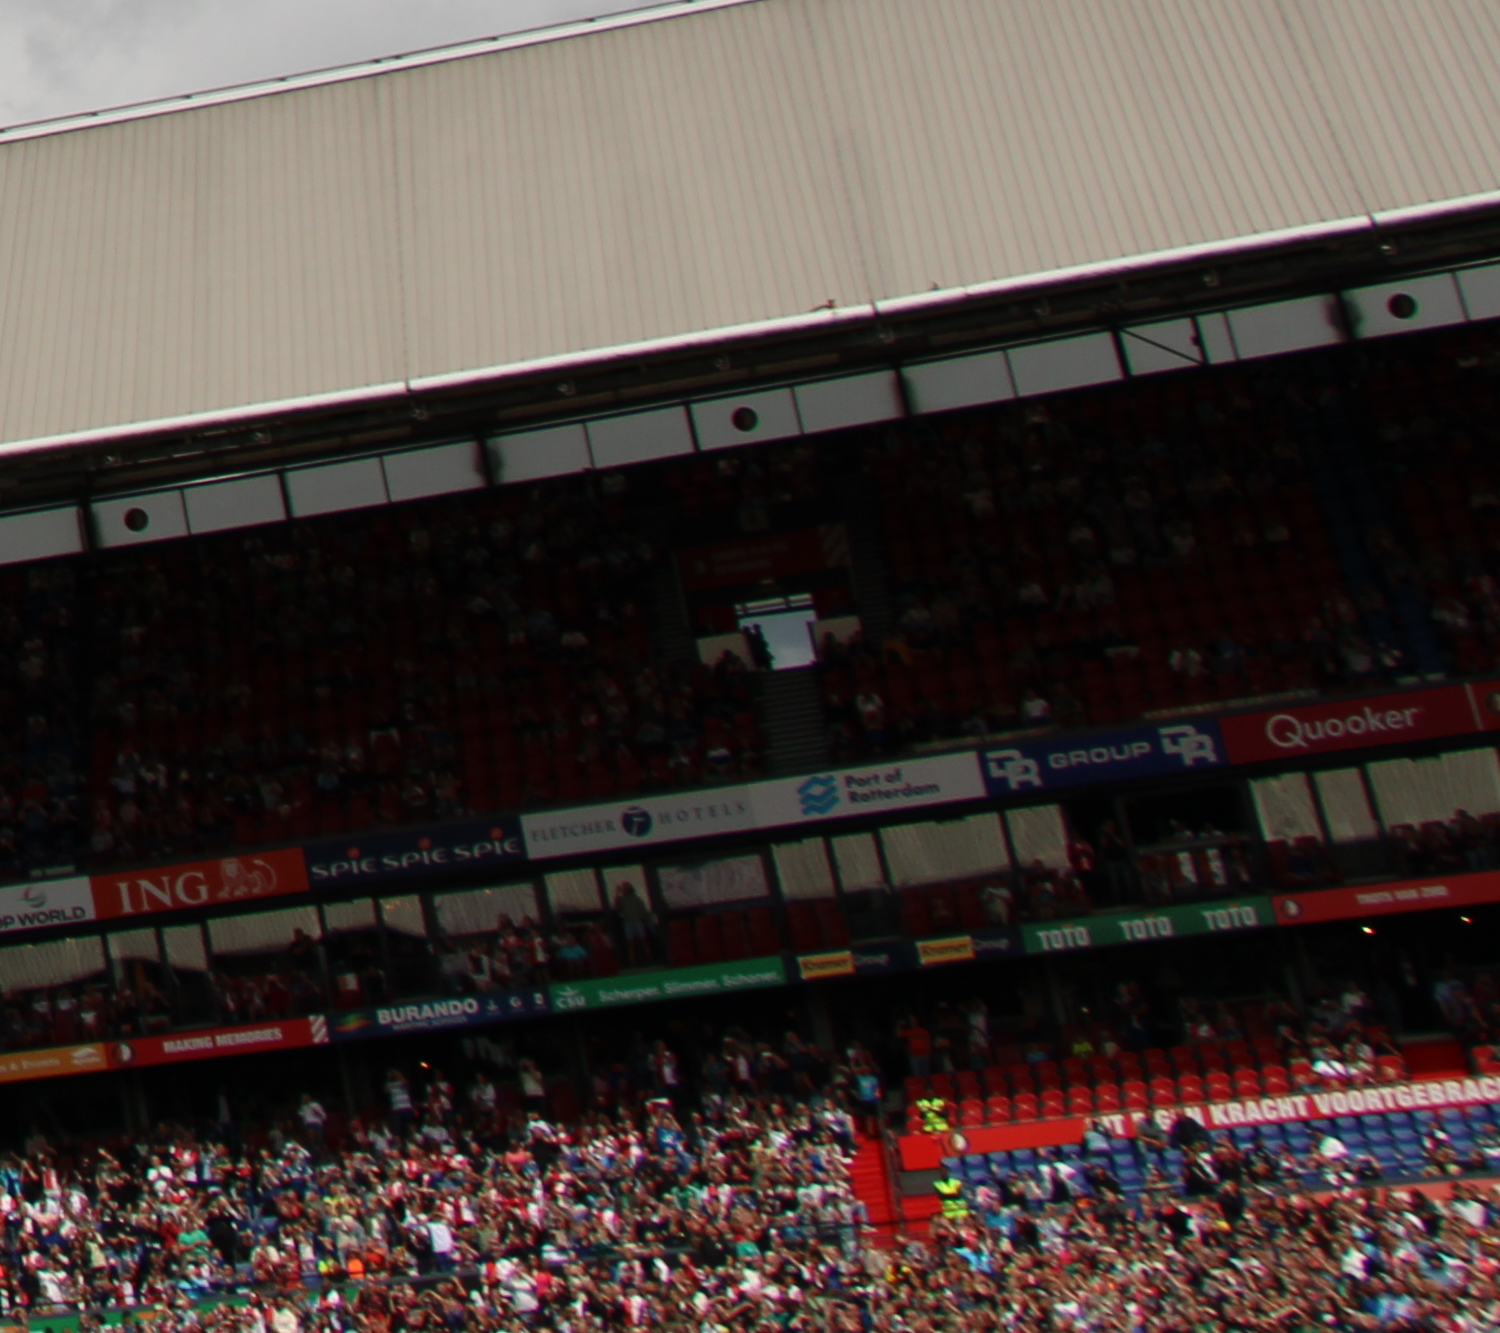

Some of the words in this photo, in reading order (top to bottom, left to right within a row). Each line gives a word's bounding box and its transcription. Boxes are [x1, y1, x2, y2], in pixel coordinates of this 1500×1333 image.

[1265, 706, 1420, 748] Quooker
[1048, 741, 1151, 769] GROUP
[845, 774, 880, 787] Port
[885, 767, 902, 783] of
[848, 783, 940, 803] Rotterdam
[530, 820, 616, 842] FLETCHER
[659, 801, 746, 825] HOTELS
[385, 842, 448, 871] SPIE
[453, 831, 522, 862] SPIE
[310, 851, 378, 880] SPIE
[116, 870, 209, 914] ING
[18, 907, 86, 927] WORLD
[1118, 916, 1175, 941] TOTO
[1202, 906, 1259, 931] TOTO
[1037, 926, 1092, 951] TOTO
[376, 997, 481, 1025] BURANDO
[162, 1036, 214, 1054] MAKING
[215, 1027, 283, 1047] MEMORIES
[1209, 1095, 1309, 1125] KRACHT
